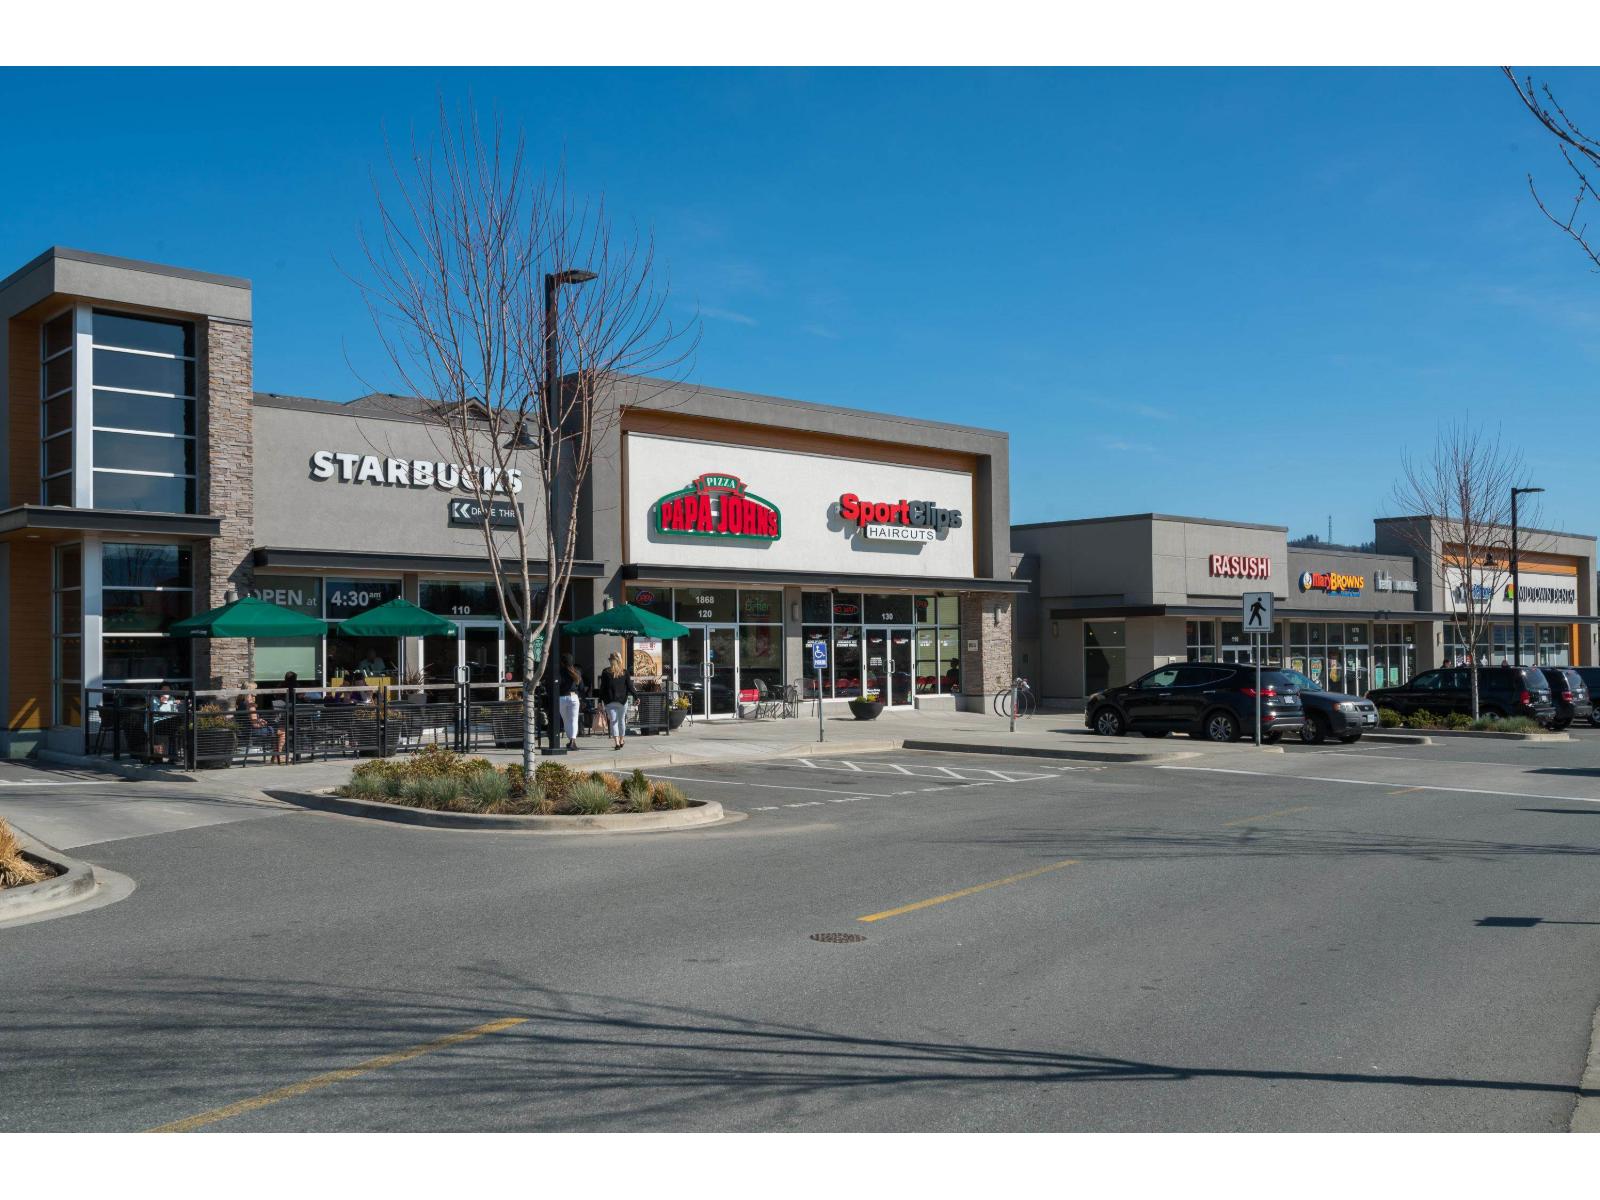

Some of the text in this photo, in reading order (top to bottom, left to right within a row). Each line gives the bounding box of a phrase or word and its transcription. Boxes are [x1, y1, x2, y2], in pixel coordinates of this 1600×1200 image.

[311, 450, 523, 494] STARBUCKS
[706, 477, 736, 489] PIZZA
[471, 507, 516, 518] DRE THR
[661, 495, 713, 532] PAPA
[869, 527, 934, 540] HAIRCUTS
[1212, 555, 1271, 577] RASUSHI
[306, 598, 317, 606] at
[696, 596, 715, 604] 1868
[451, 605, 471, 615] 110
[698, 610, 712, 618] 120
